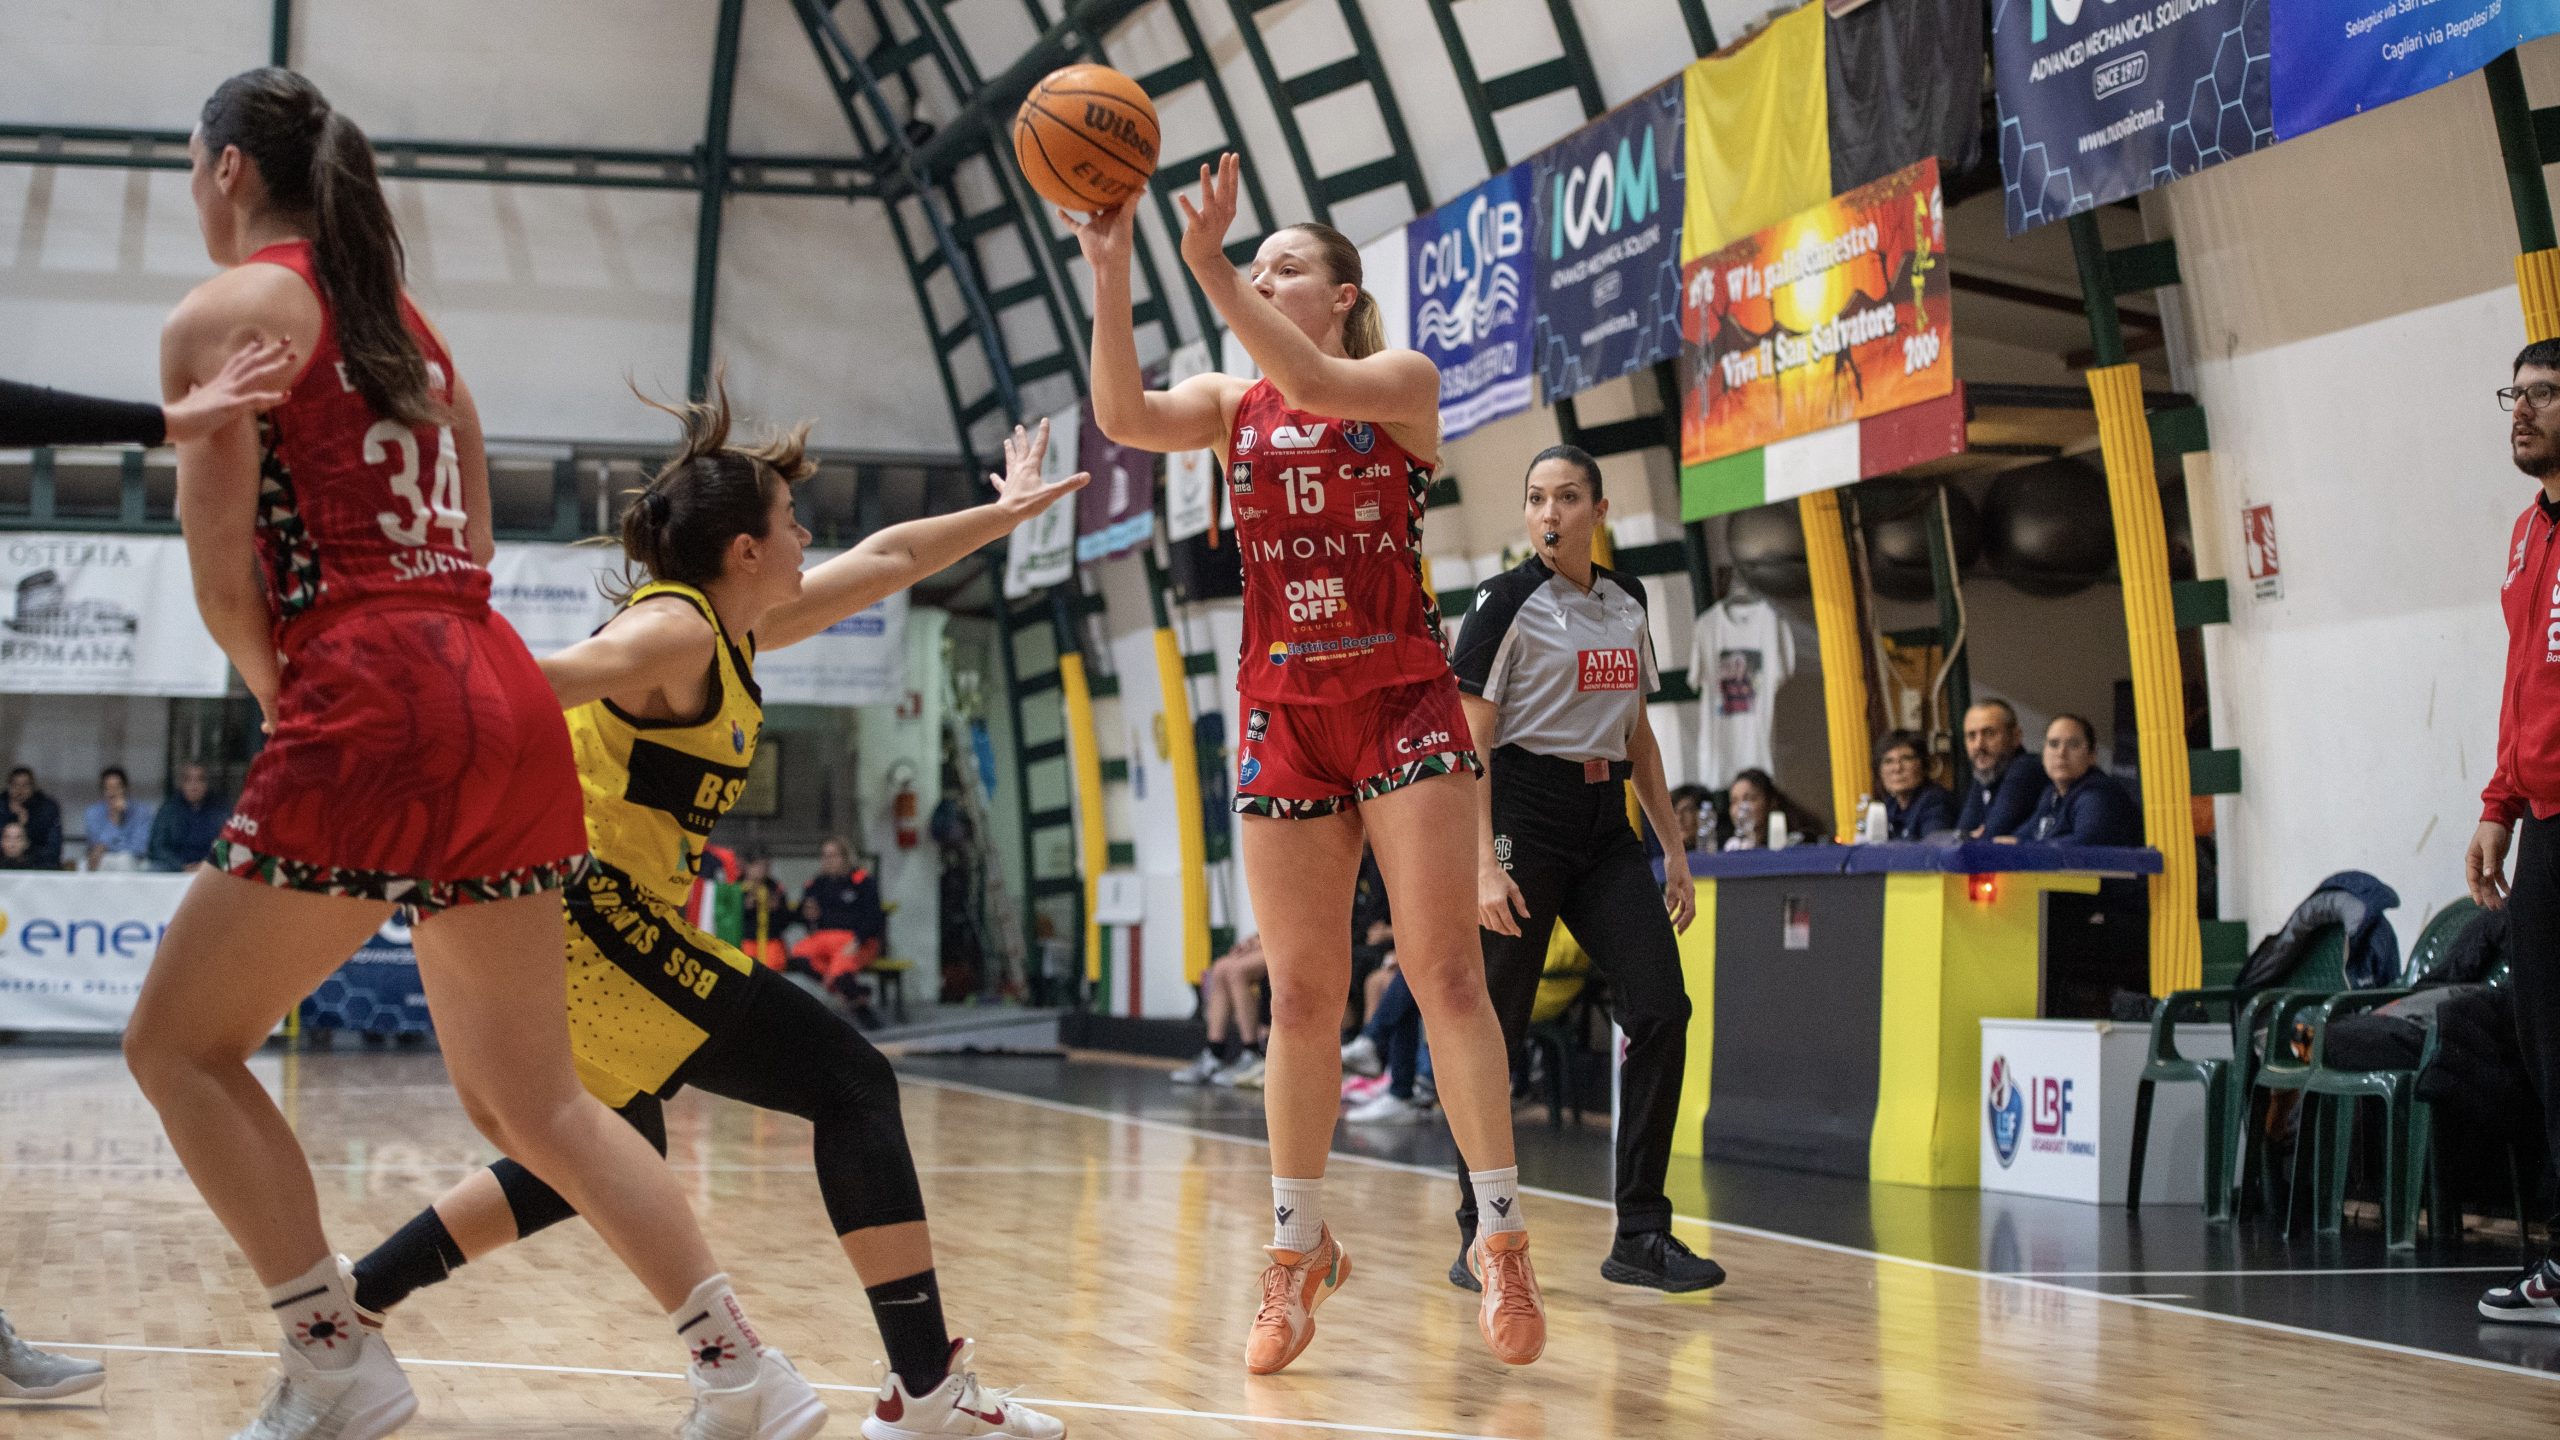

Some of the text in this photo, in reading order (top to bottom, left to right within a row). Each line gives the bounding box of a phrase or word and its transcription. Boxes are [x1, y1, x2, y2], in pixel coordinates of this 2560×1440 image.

[2029, 40, 2086, 83] ADVANCED
[2084, 11, 2154, 58] MECHANICAL
[2345, 12, 2383, 38] Selargius
[2382, 31, 2423, 60] Cagliari
[2425, 27, 2443, 46] via
[2446, 6, 2488, 40] Pergolesi
[2096, 57, 2144, 93] SINCE 1977
[1552, 123, 1660, 261] ICOM
[1418, 195, 1524, 296] COLSUB
[1726, 264, 1746, 302] W
[1721, 350, 1758, 388] Viva
[1775, 331, 1809, 372] San
[1811, 302, 1896, 363] Salvatore
[1903, 327, 1940, 376] 2006
[363, 418, 468, 552] 34
[1279, 466, 1326, 515] 15
[1285, 577, 1345, 602] ONE
[1289, 598, 1338, 623] OFF
[1341, 633, 1397, 649] Rogeno
[1585, 650, 1634, 670] ATTAL
[1584, 669, 1635, 683] GROUP
[663, 947, 719, 1000] BSS
[2032, 1076, 2074, 1136] LBF
